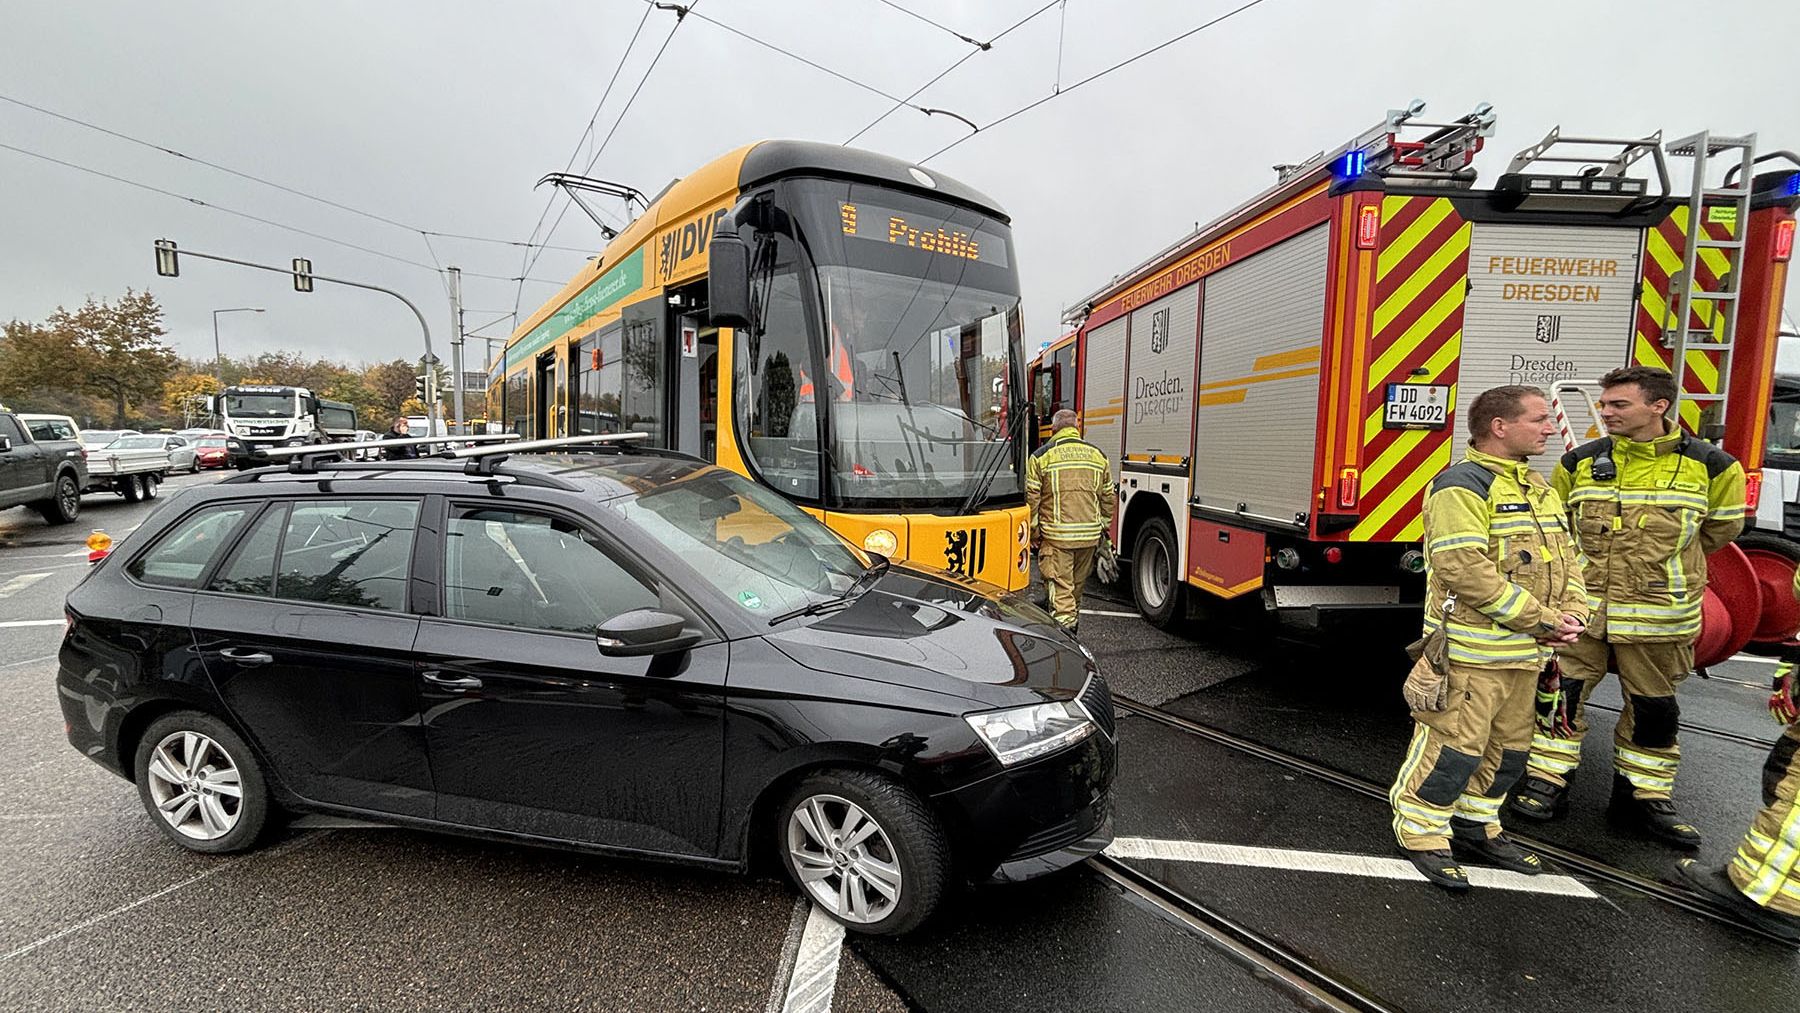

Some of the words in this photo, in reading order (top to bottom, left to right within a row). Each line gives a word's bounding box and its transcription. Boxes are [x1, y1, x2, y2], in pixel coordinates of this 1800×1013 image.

[1488, 256, 1618, 277] FEUERWEHR
[1121, 274, 1173, 312] FEUERWEHR
[1176, 243, 1231, 286] DRESDEN
[1502, 283, 1601, 302] DRESDEN
[1510, 354, 1578, 371] Dresden.
[1135, 369, 1184, 399] Dresden.
[1400, 388, 1418, 403] DD
[1389, 404, 1407, 420] FW
[1410, 404, 1443, 421] 4092
